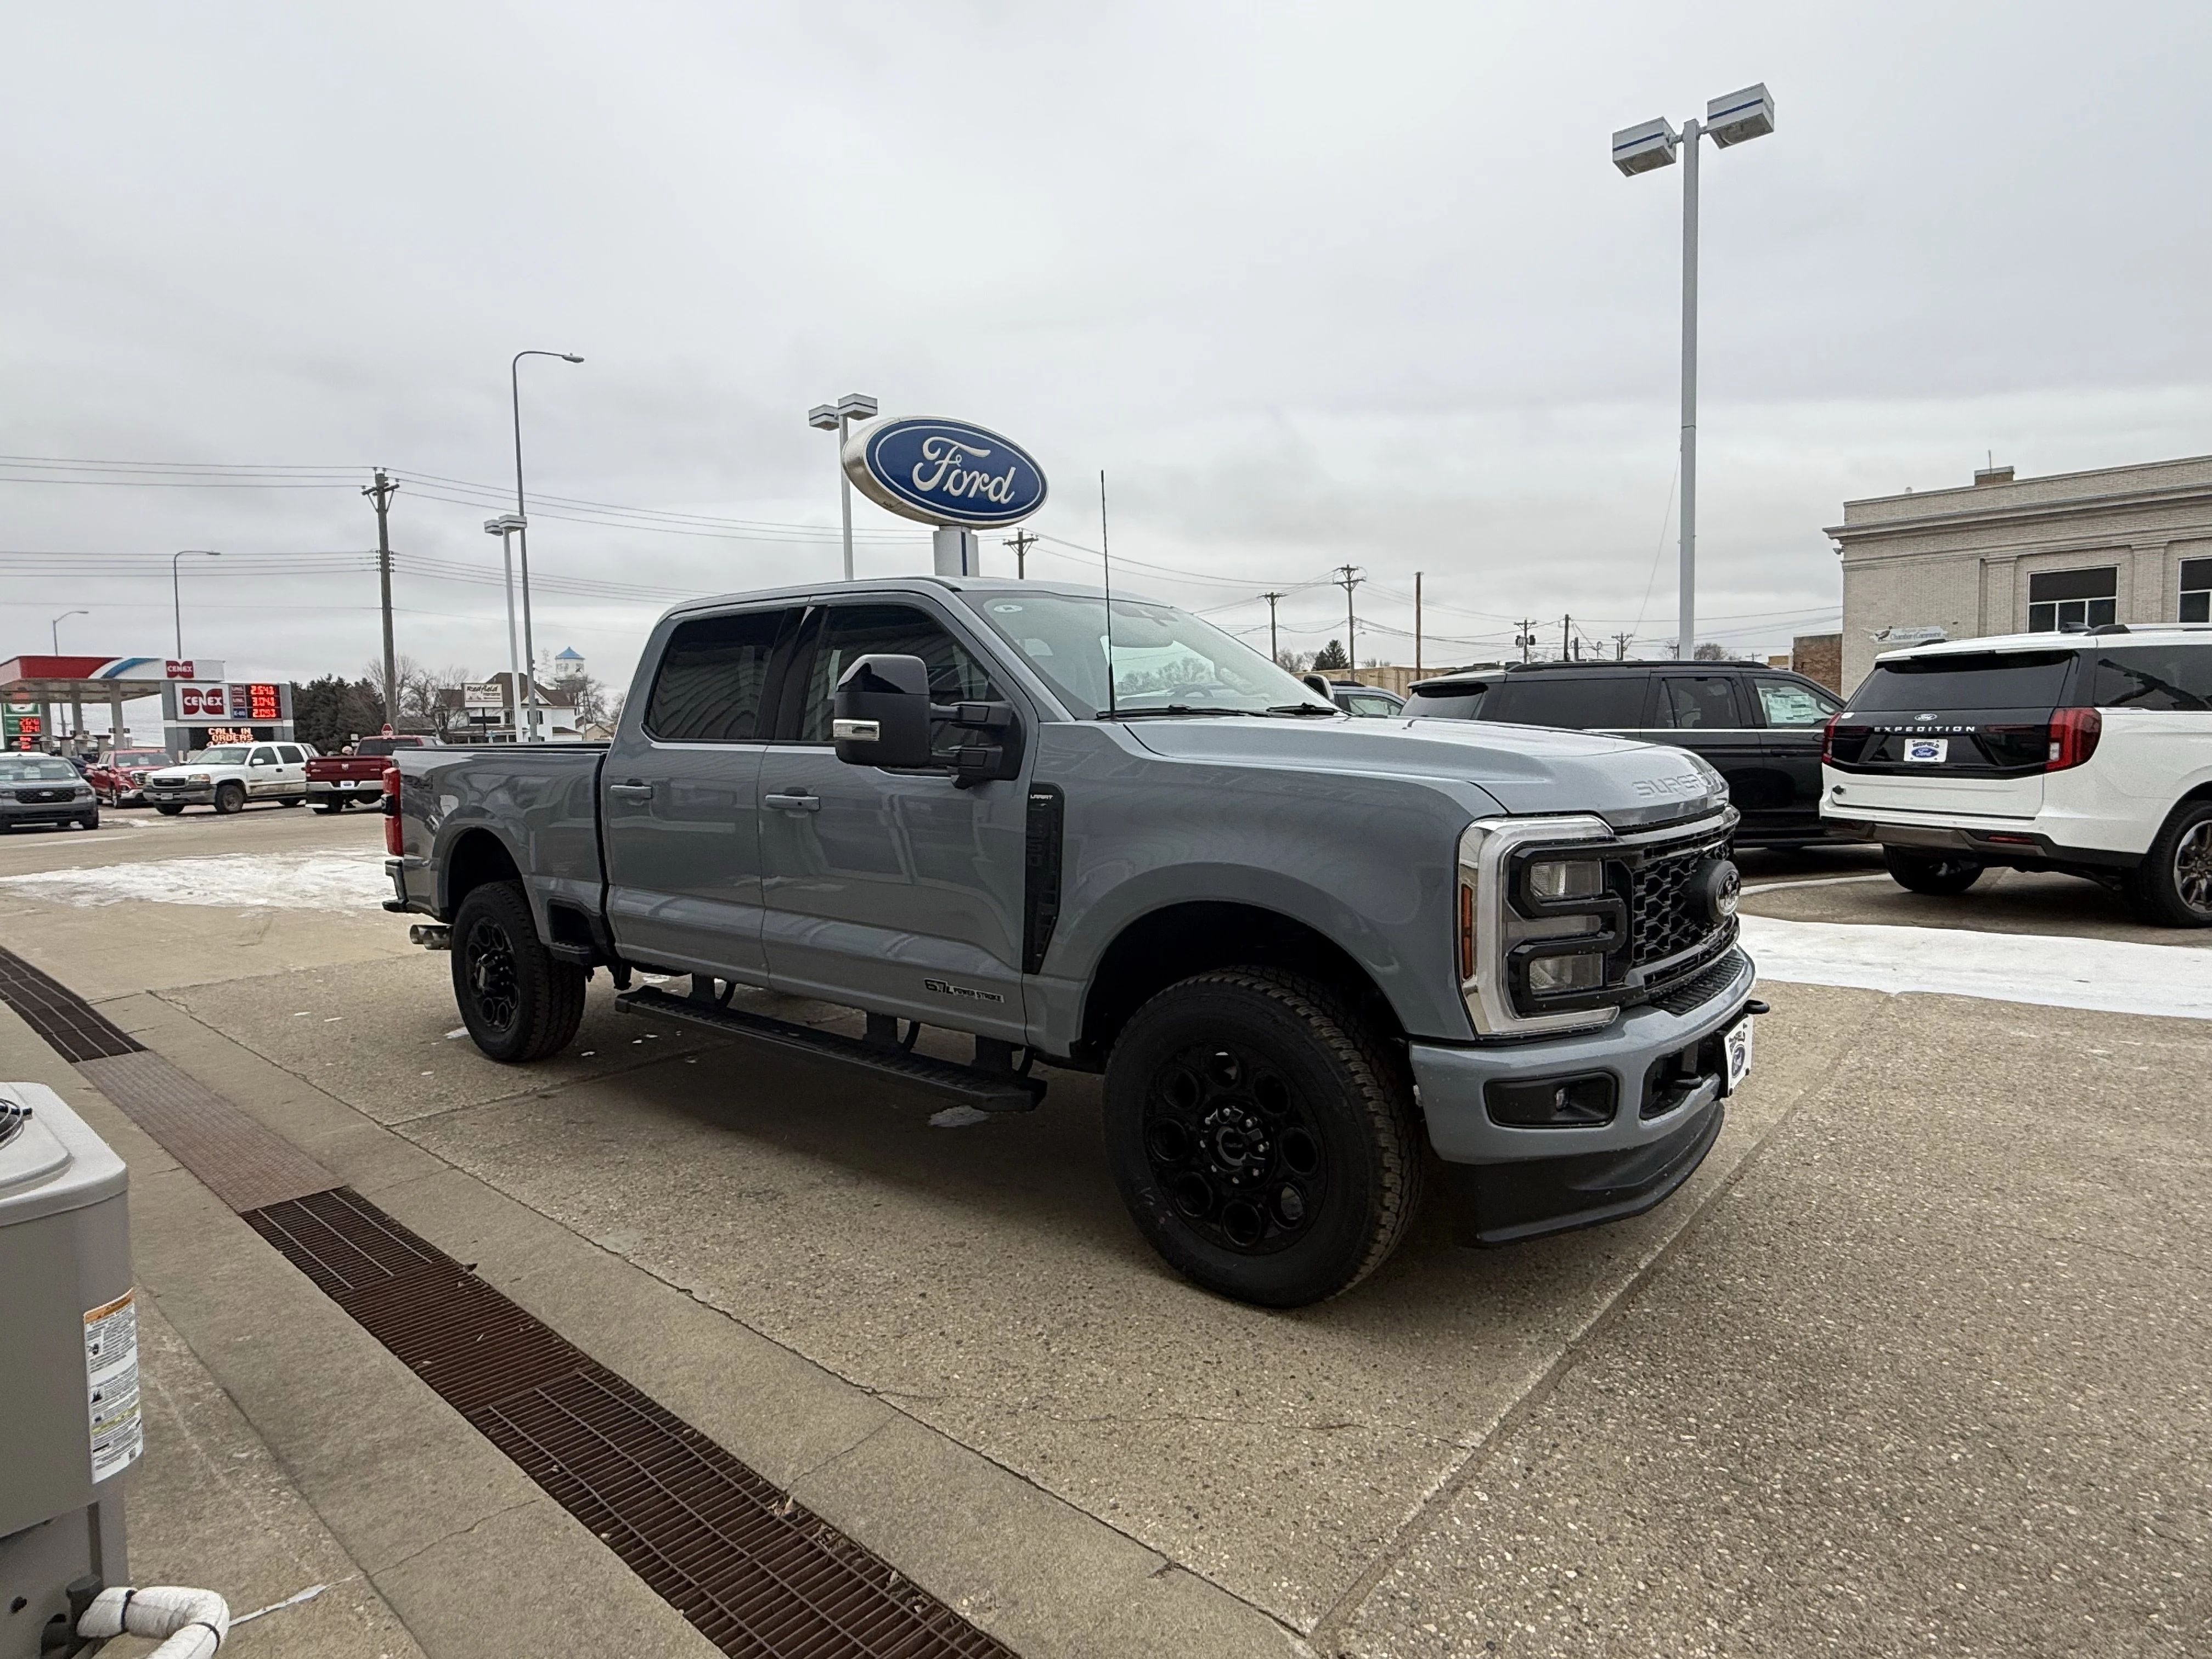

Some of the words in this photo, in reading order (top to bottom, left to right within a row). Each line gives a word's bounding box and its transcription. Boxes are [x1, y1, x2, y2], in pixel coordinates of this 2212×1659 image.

[912, 437, 1017, 504] Ford
[184, 696, 223, 706] CENEX
[924, 978, 954, 995] 6.7L
[953, 986, 976, 998] POWER
[976, 990, 1005, 1003] STROKE
